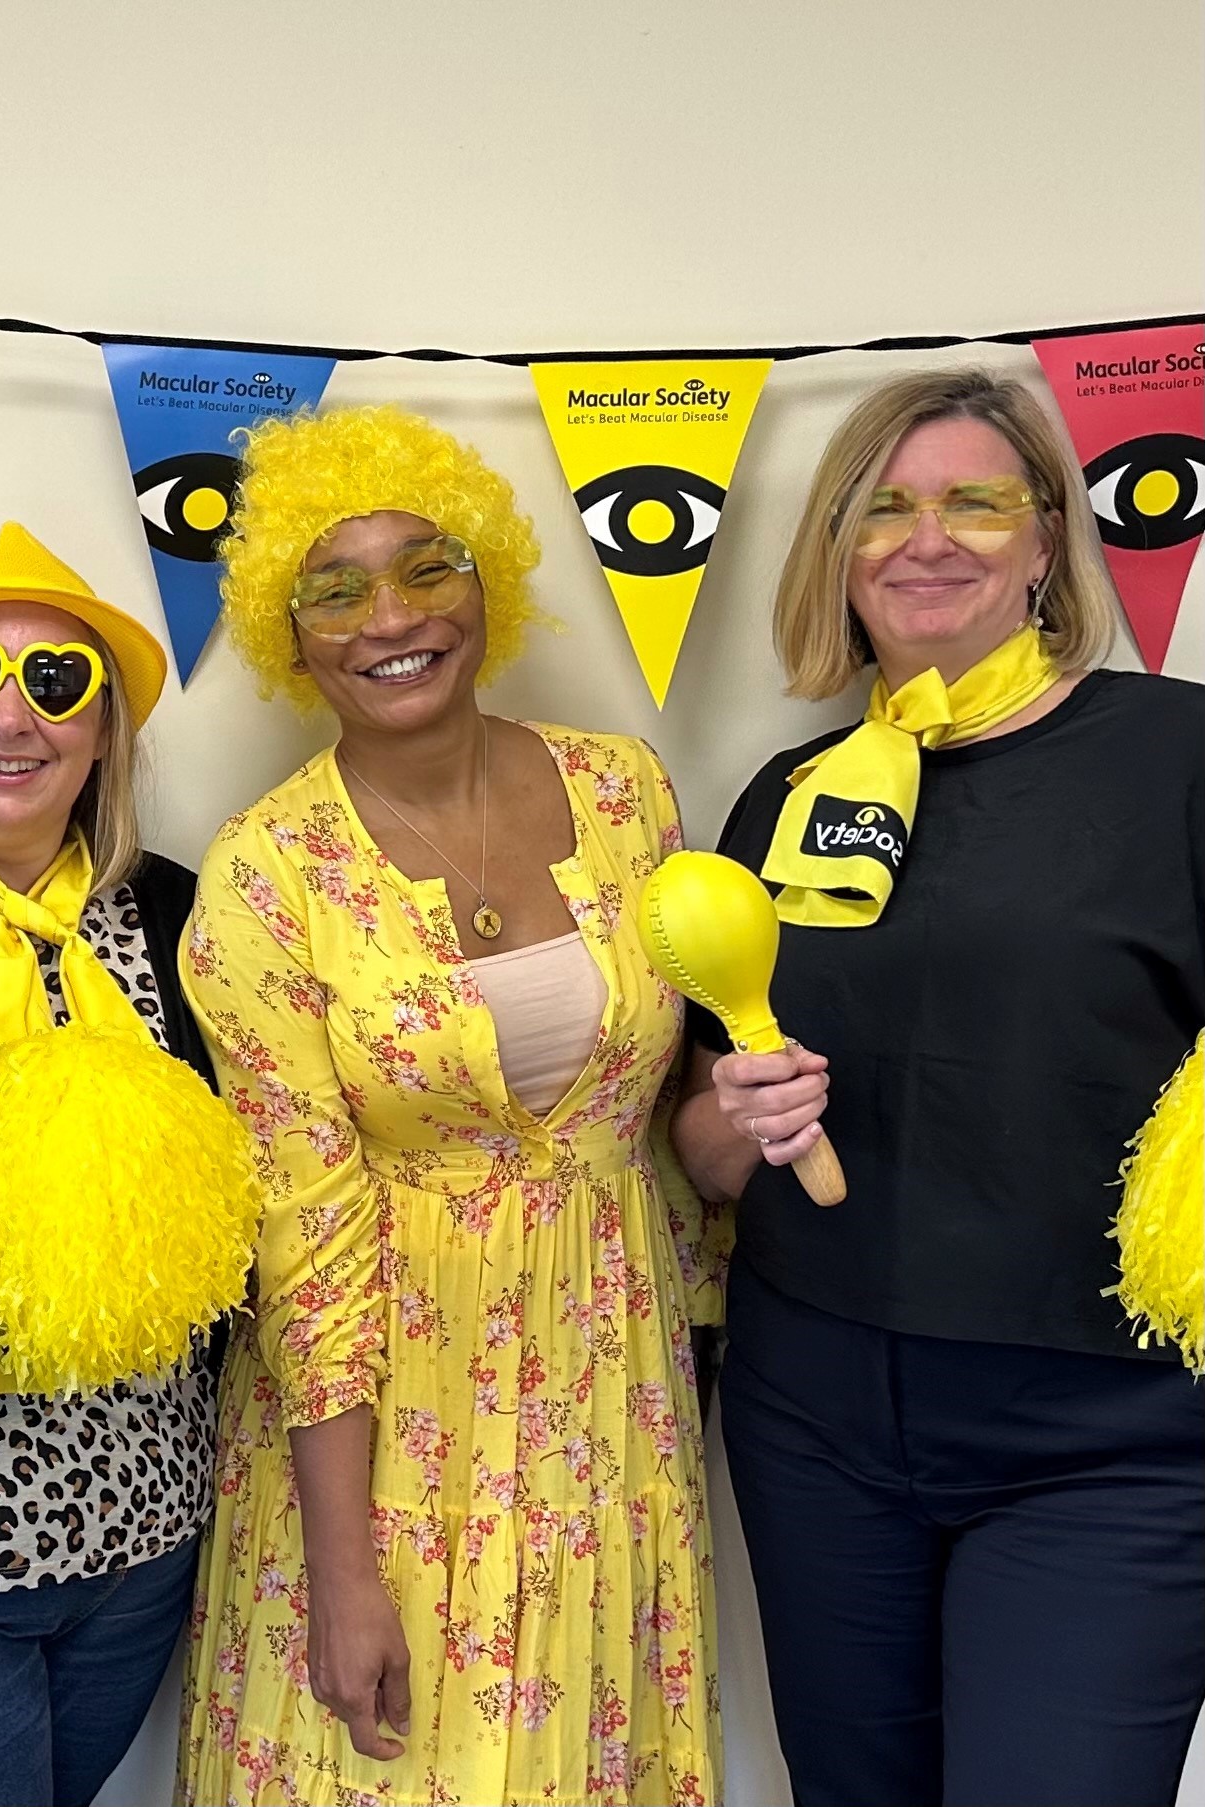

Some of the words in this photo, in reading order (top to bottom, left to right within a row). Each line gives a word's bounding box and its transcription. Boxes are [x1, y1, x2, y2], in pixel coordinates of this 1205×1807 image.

[1076, 356, 1160, 380] Macular
[139, 371, 220, 395] Macular
[223, 378, 297, 405] Society
[568, 388, 650, 408] Macular
[655, 387, 731, 410] Society
[1076, 385, 1106, 397] Let's
[1109, 383, 1137, 395] Beat
[1141, 378, 1190, 392] Macular
[137, 395, 164, 407] Let's
[168, 397, 194, 410] Beat
[198, 399, 245, 413] Macular
[248, 403, 293, 417] Disease
[567, 413, 595, 424] Let's
[599, 413, 626, 424] Beat
[630, 412, 678, 423] Macular
[682, 411, 729, 422] Disease
